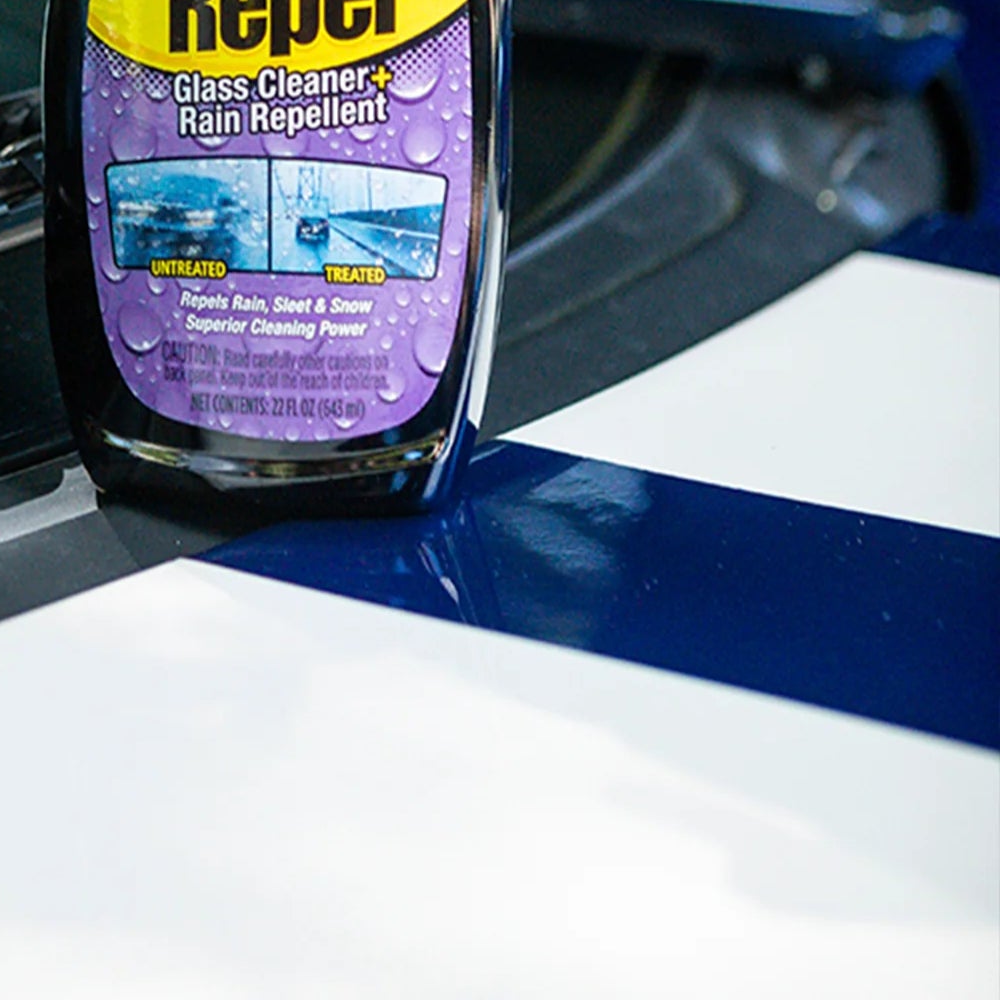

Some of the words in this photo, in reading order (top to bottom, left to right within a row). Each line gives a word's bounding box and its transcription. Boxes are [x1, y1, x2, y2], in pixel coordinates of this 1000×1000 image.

[173, 73, 248, 103] Glass
[179, 107, 244, 136] Rain
[251, 95, 387, 136] Repellent
[151, 260, 226, 278] UNTREATED
[325, 266, 385, 283] TREATED
[181, 291, 229, 310] Repels
[232, 294, 269, 314] Rain,
[273, 297, 312, 313] Sleet
[315, 297, 326, 313] &
[330, 297, 373, 313] Snow
[185, 314, 247, 333] Superior
[251, 319, 316, 339] Cleaning
[320, 320, 367, 336] Power
[162, 341, 220, 364] CAUTION:
[190, 393, 210, 412] NET
[213, 394, 268, 415] CONTENTS:
[272, 397, 285, 416] 22
[287, 398, 298, 416] FL
[300, 398, 315, 417] OZ
